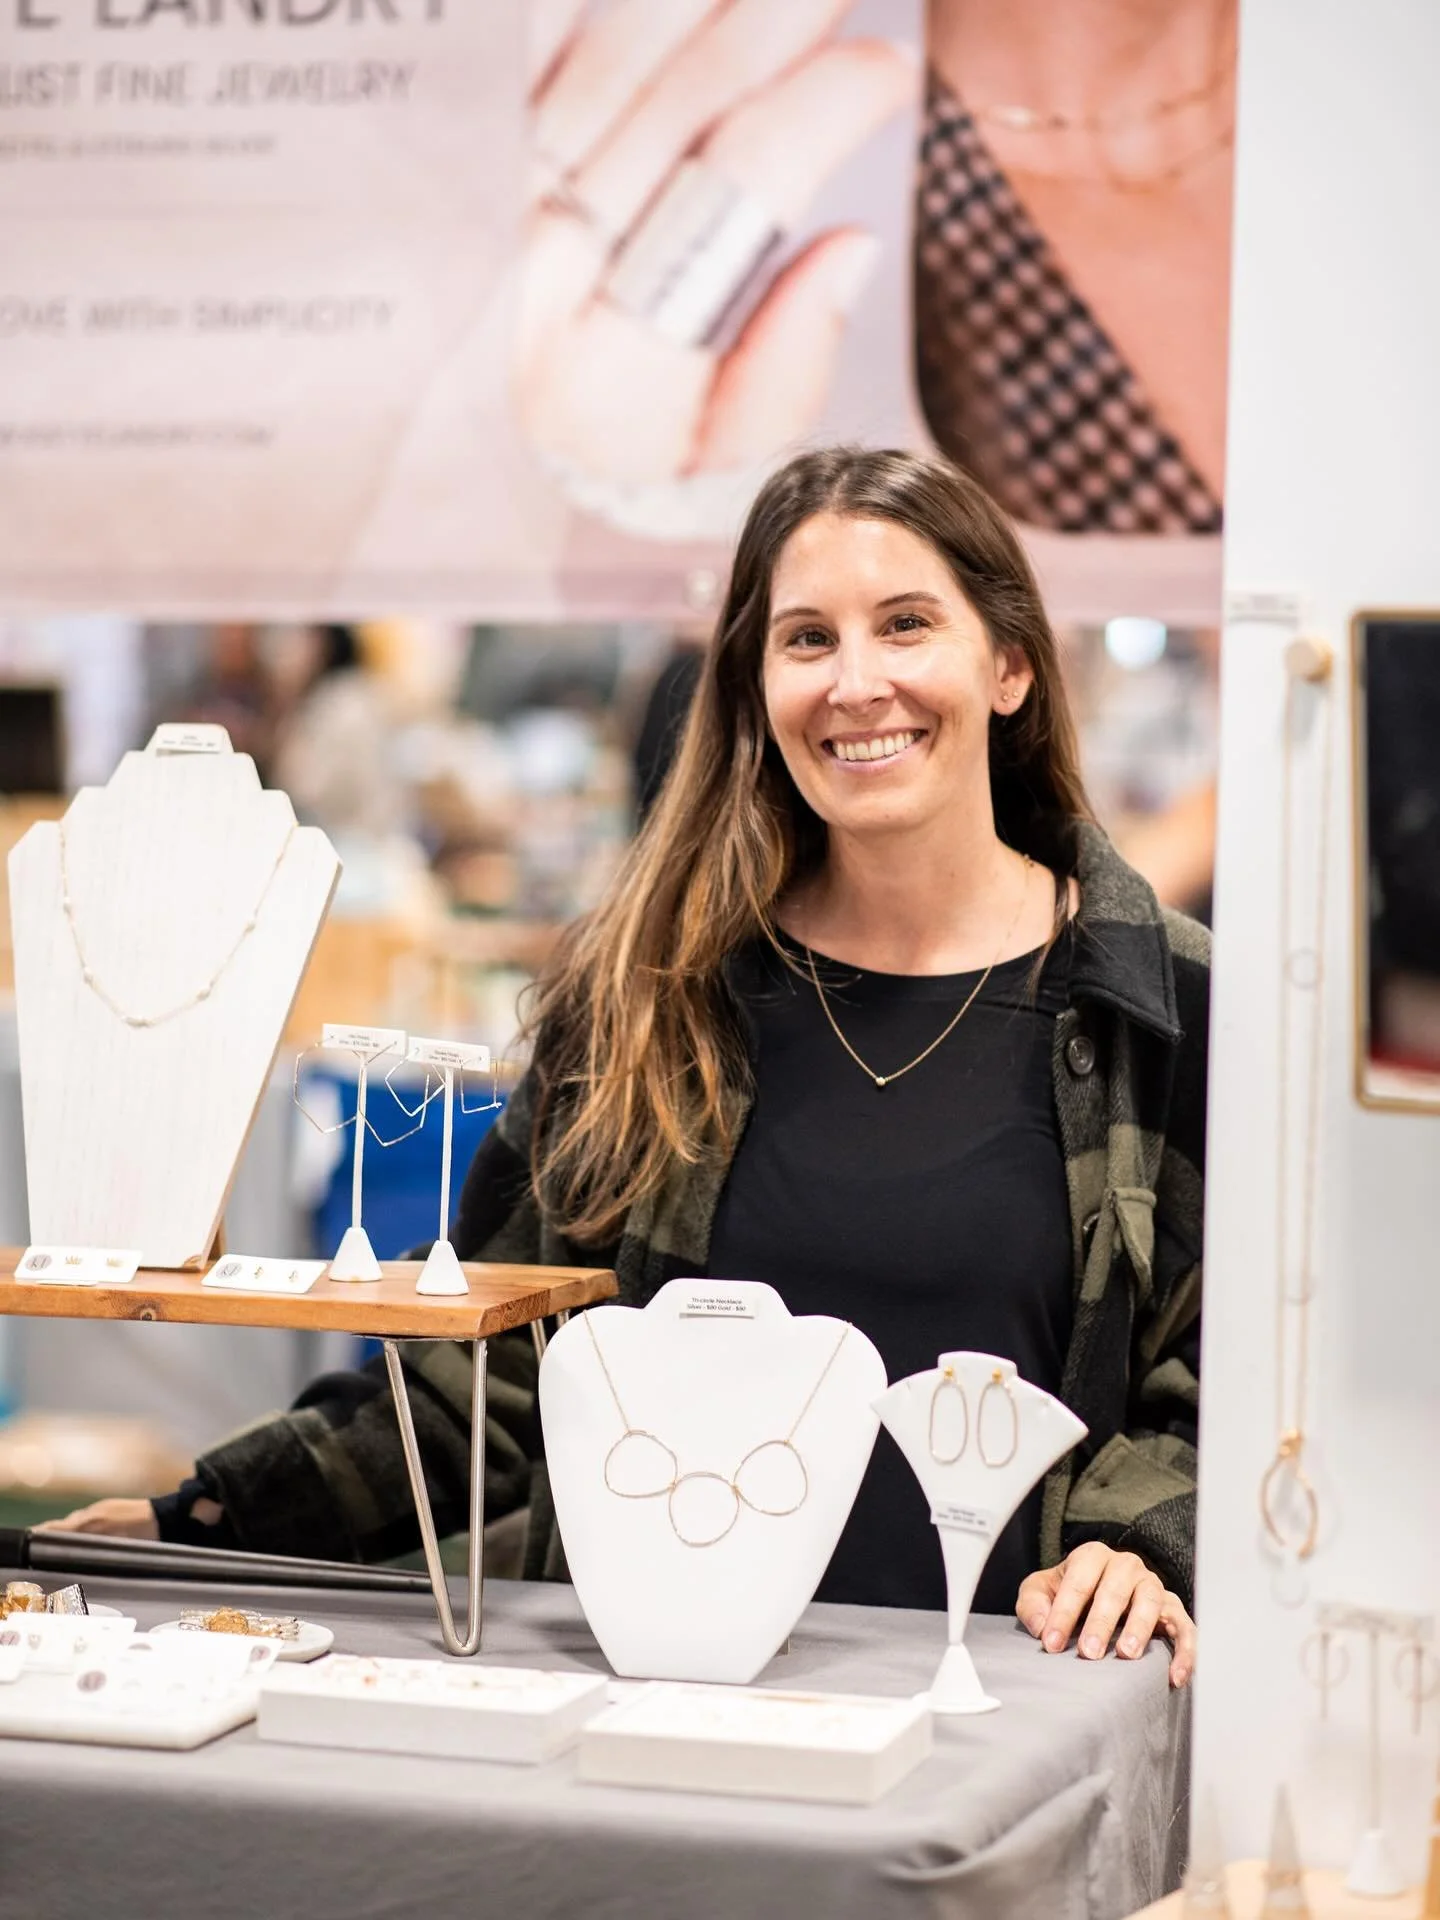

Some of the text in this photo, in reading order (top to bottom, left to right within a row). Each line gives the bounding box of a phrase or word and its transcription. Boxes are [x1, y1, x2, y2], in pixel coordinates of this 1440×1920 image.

[95, 61, 192, 106] FINE
[207, 60, 418, 106] JEWELRY
[192, 295, 397, 337] SIMPLICITY
